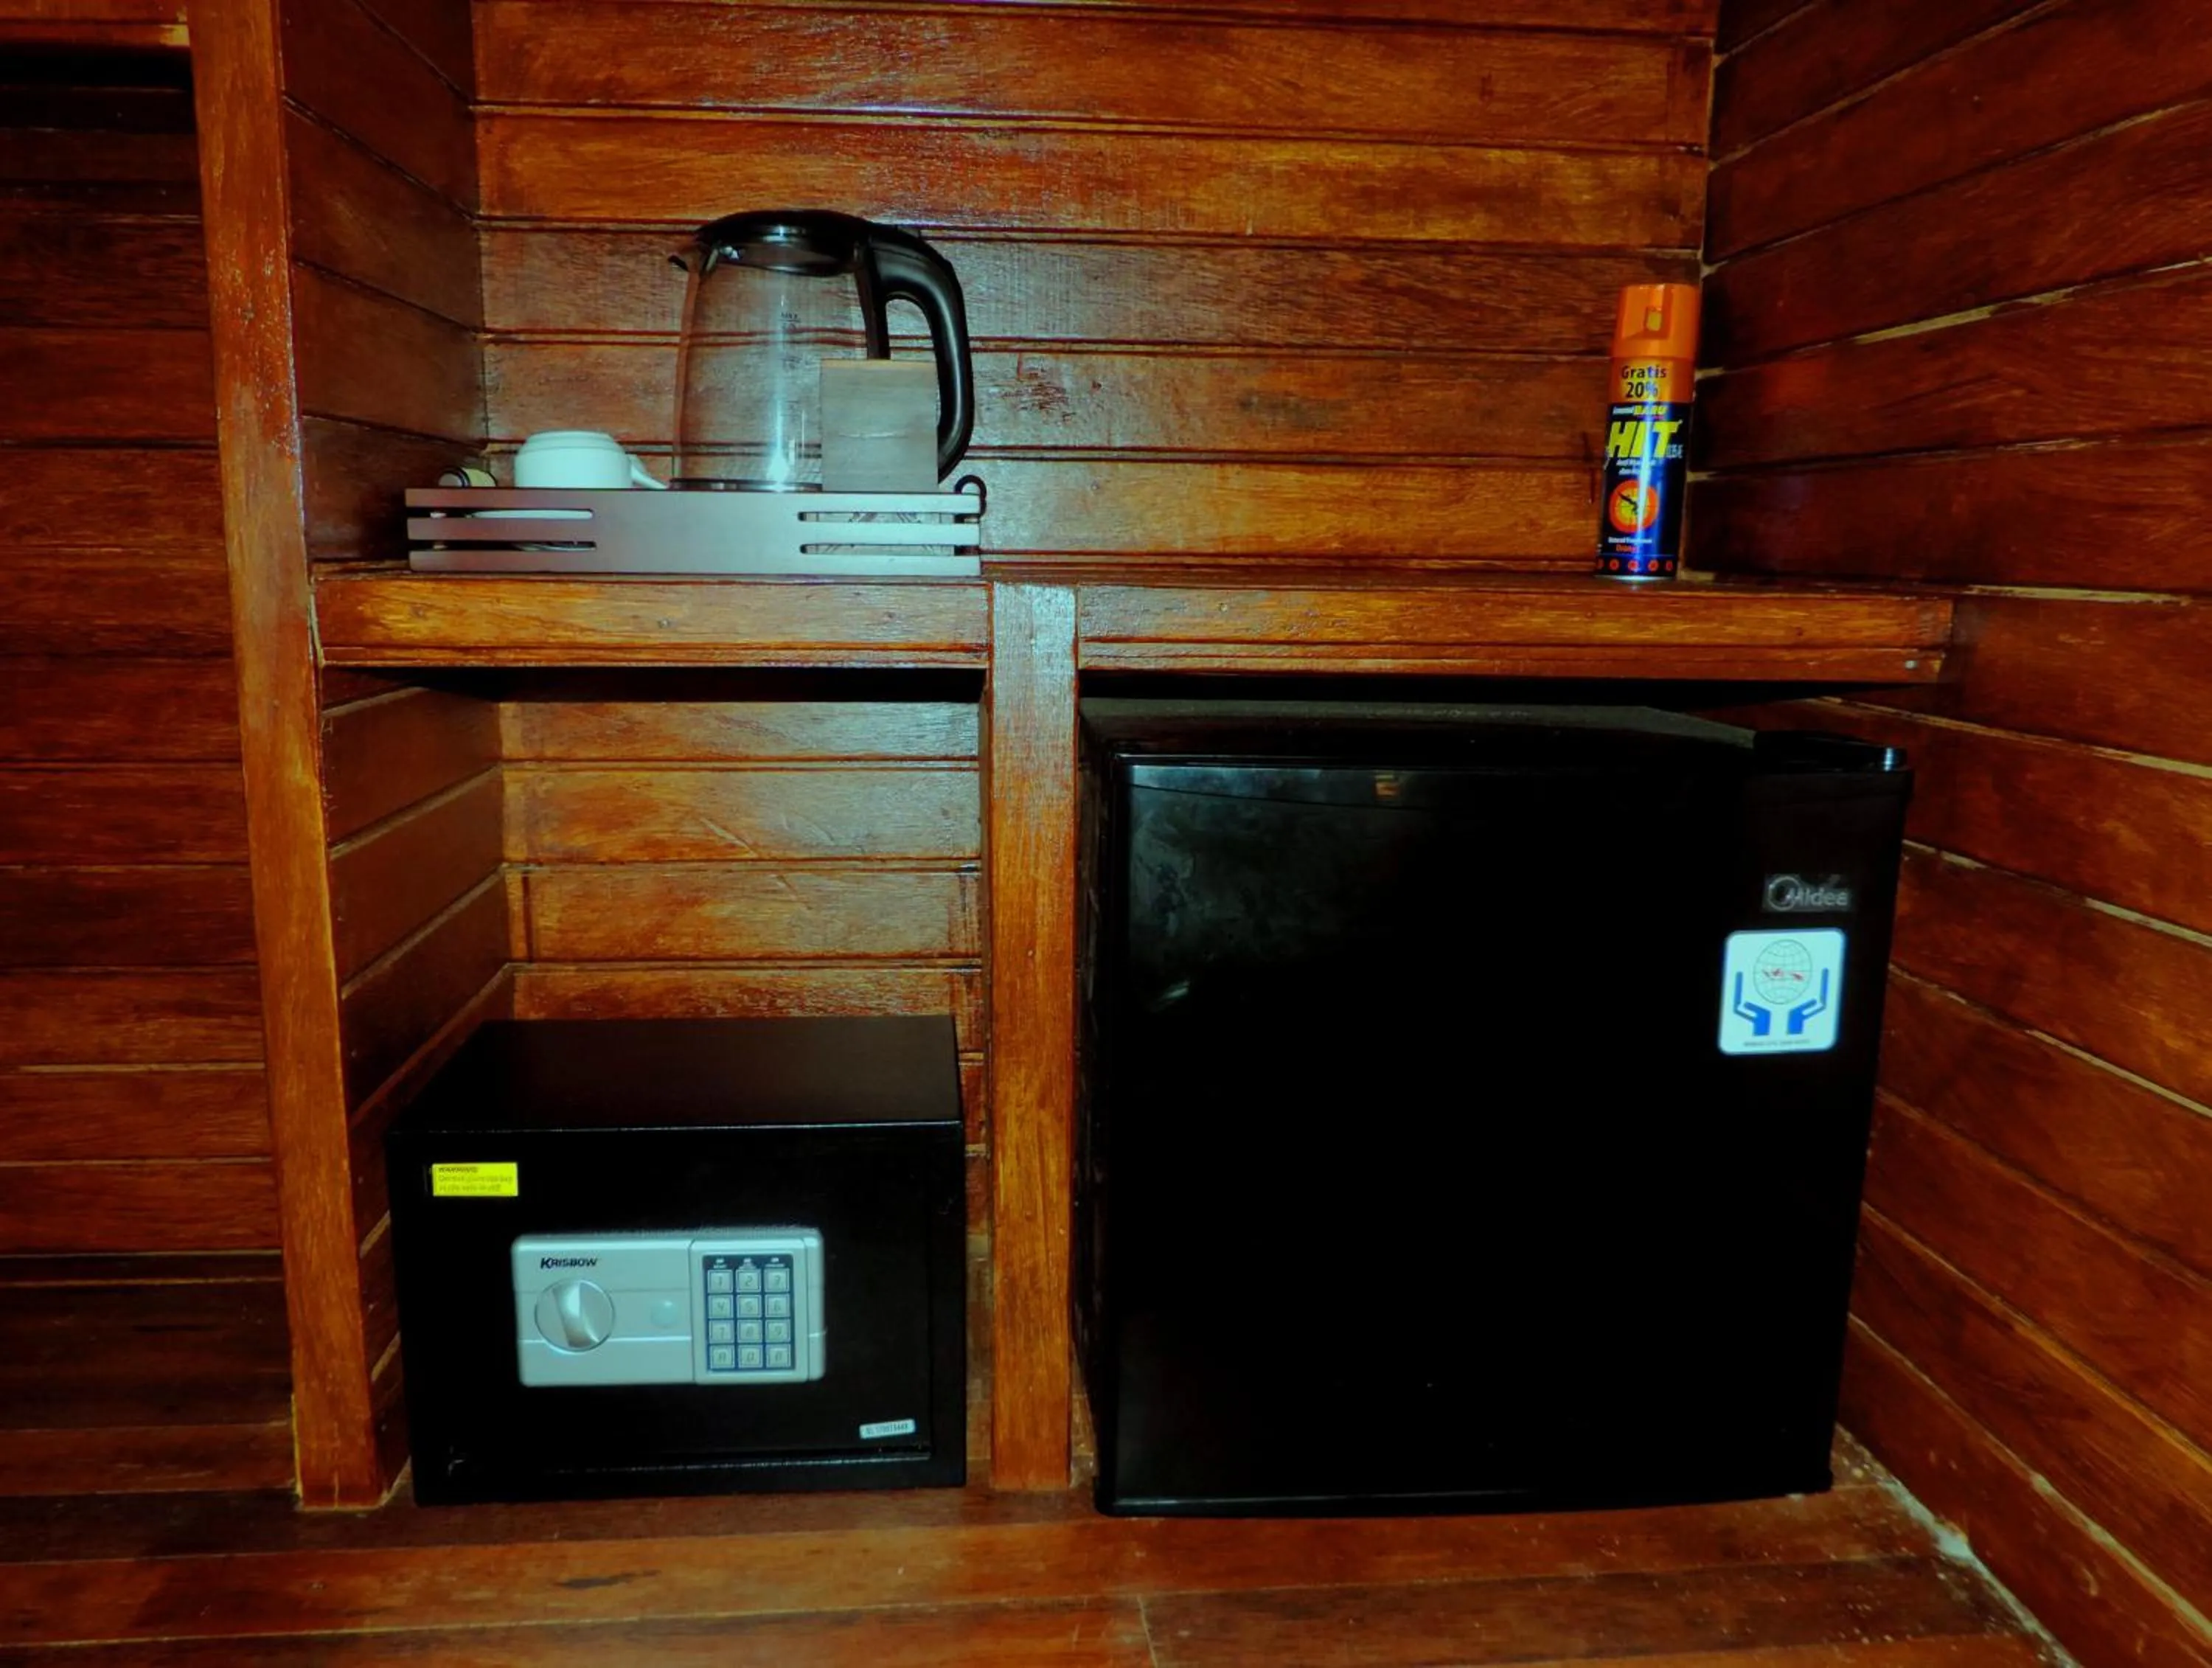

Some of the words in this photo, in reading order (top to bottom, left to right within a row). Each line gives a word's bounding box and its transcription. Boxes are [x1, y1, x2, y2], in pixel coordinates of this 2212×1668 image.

[1621, 365, 1667, 379] Gratis
[1626, 381, 1659, 398] 20%
[1607, 420, 1680, 458] HIT
[745, 1275, 754, 1287] 2
